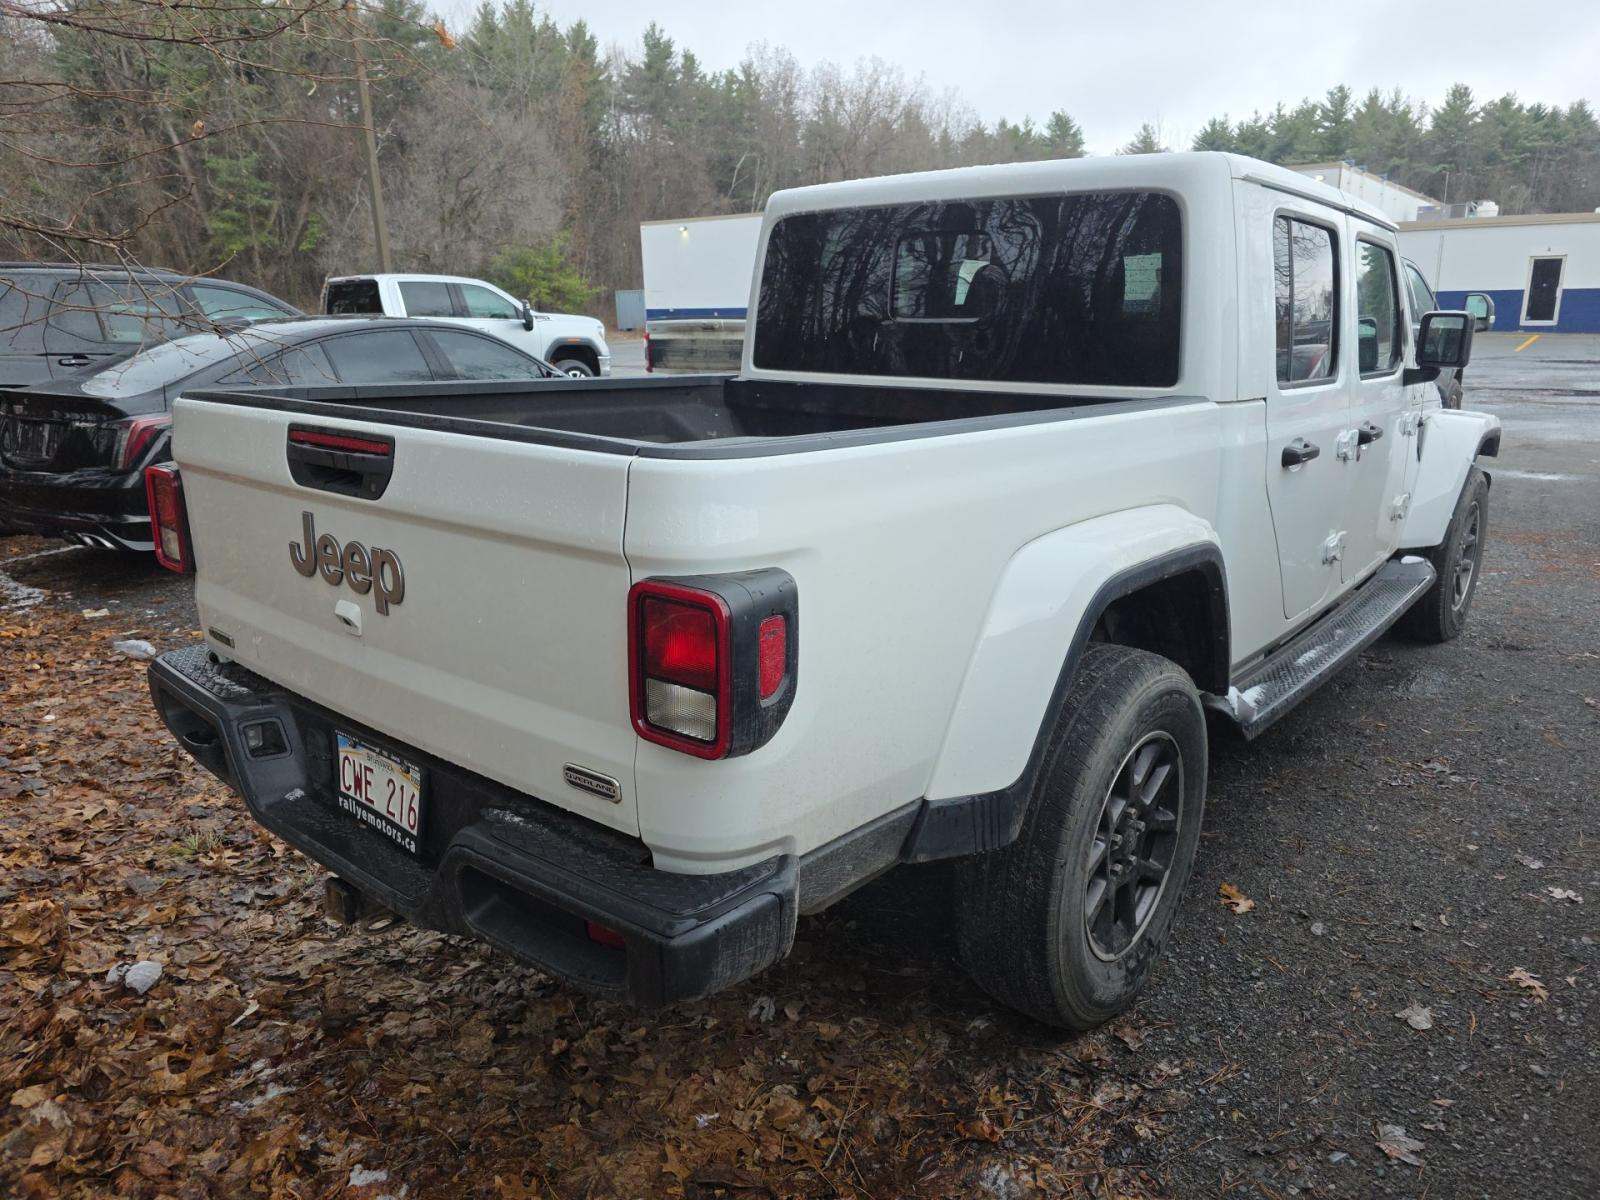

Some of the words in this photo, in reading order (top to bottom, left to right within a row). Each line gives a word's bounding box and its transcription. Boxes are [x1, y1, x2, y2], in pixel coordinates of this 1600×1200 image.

[288, 510, 405, 616] Jeep
[338, 796, 416, 854] rallyemotors.ca
[342, 755, 375, 805] CWE
[386, 777, 417, 831] 216
